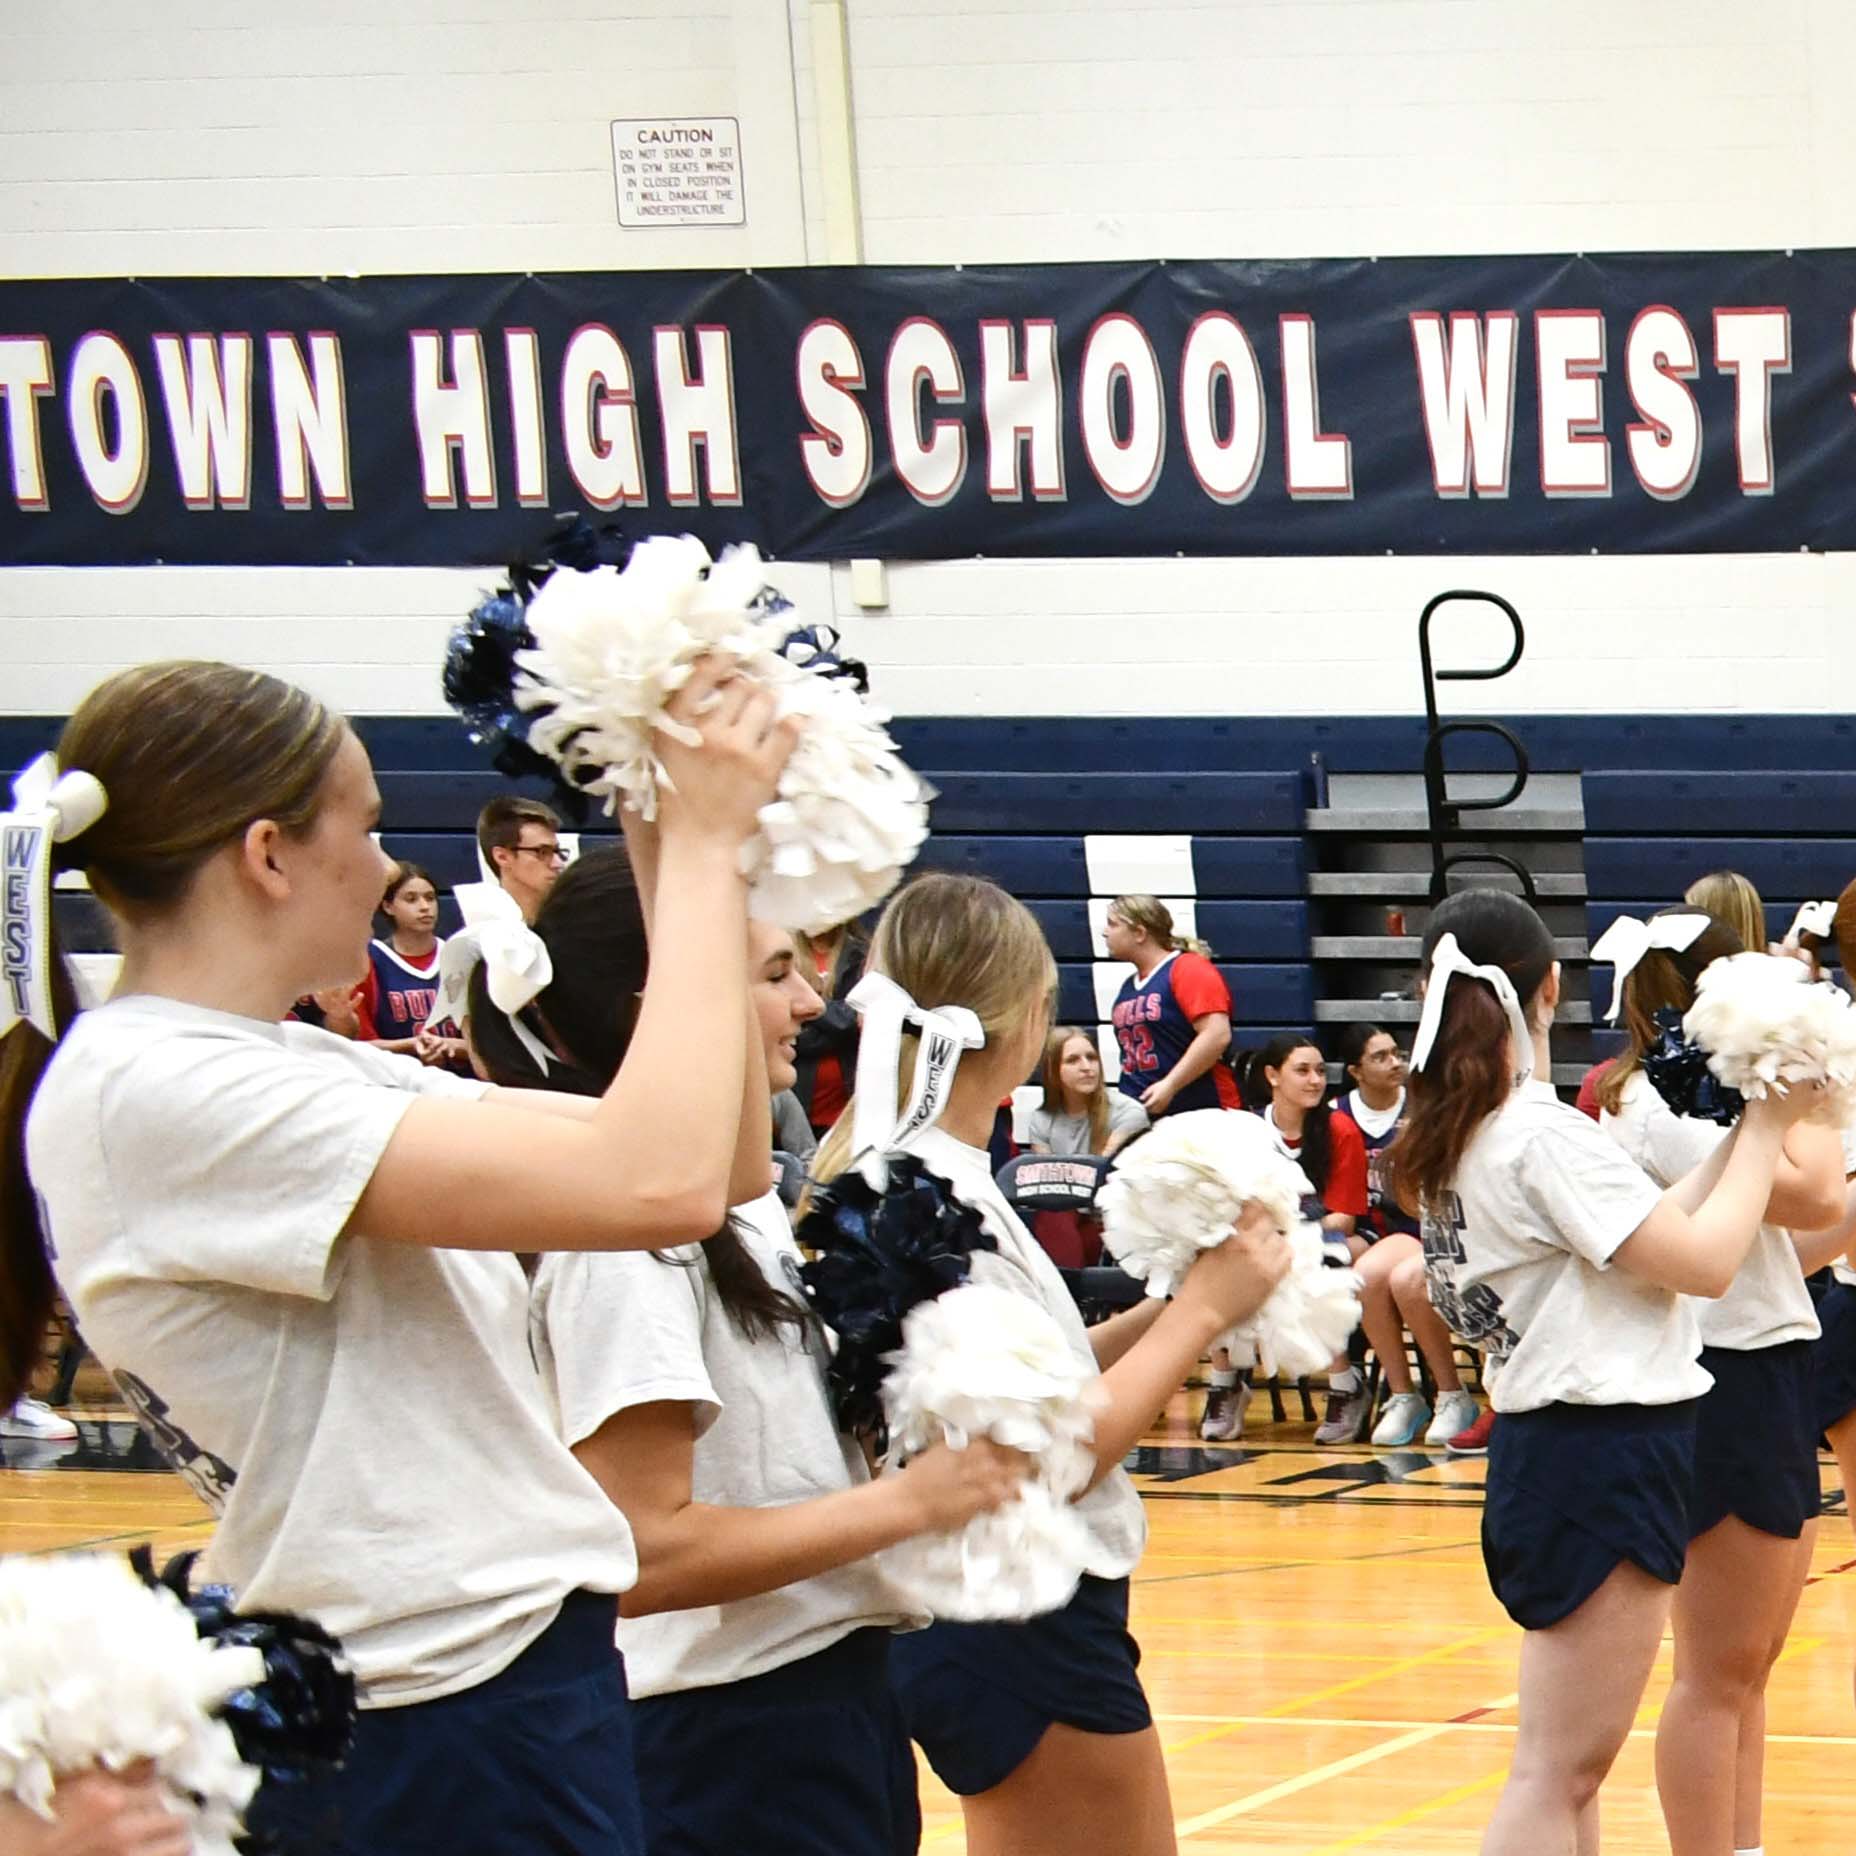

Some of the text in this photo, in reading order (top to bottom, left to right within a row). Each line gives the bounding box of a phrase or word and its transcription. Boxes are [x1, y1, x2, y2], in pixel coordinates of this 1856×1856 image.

[637, 129, 713, 143] CAUTION
[620, 147, 732, 160] DO NOT STAND OR SIT
[622, 161, 733, 174] ON GYM SEATS WHEN
[643, 177, 680, 187] CLOSED
[687, 176, 731, 186] POSITION
[641, 190, 662, 201] WILL
[669, 190, 708, 200] DAMAGE
[716, 190, 733, 200] THE
[0, 304, 1794, 514] TOWN HIGH SCHOOL WEST
[3, 826, 42, 1015] WEST
[894, 1031, 956, 1144] WEST
